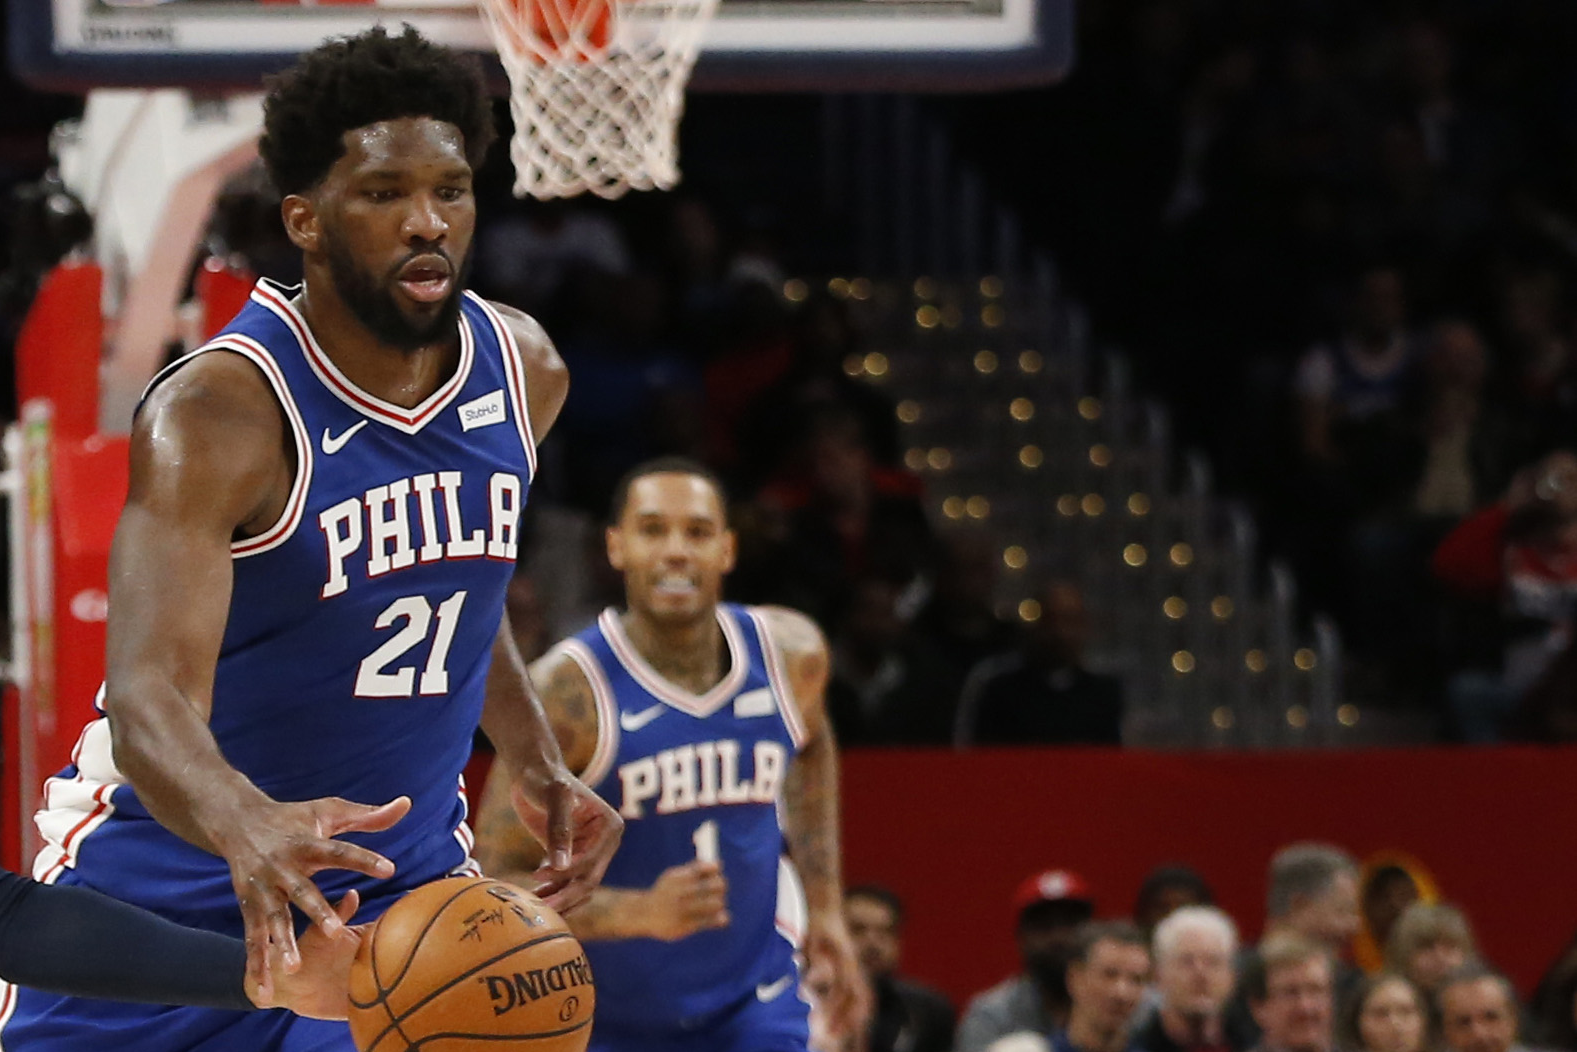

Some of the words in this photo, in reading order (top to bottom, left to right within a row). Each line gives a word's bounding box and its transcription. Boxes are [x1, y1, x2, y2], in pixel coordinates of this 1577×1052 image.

[318, 470, 521, 600] PHILA
[353, 590, 467, 698] 21
[618, 738, 788, 820] PHILA
